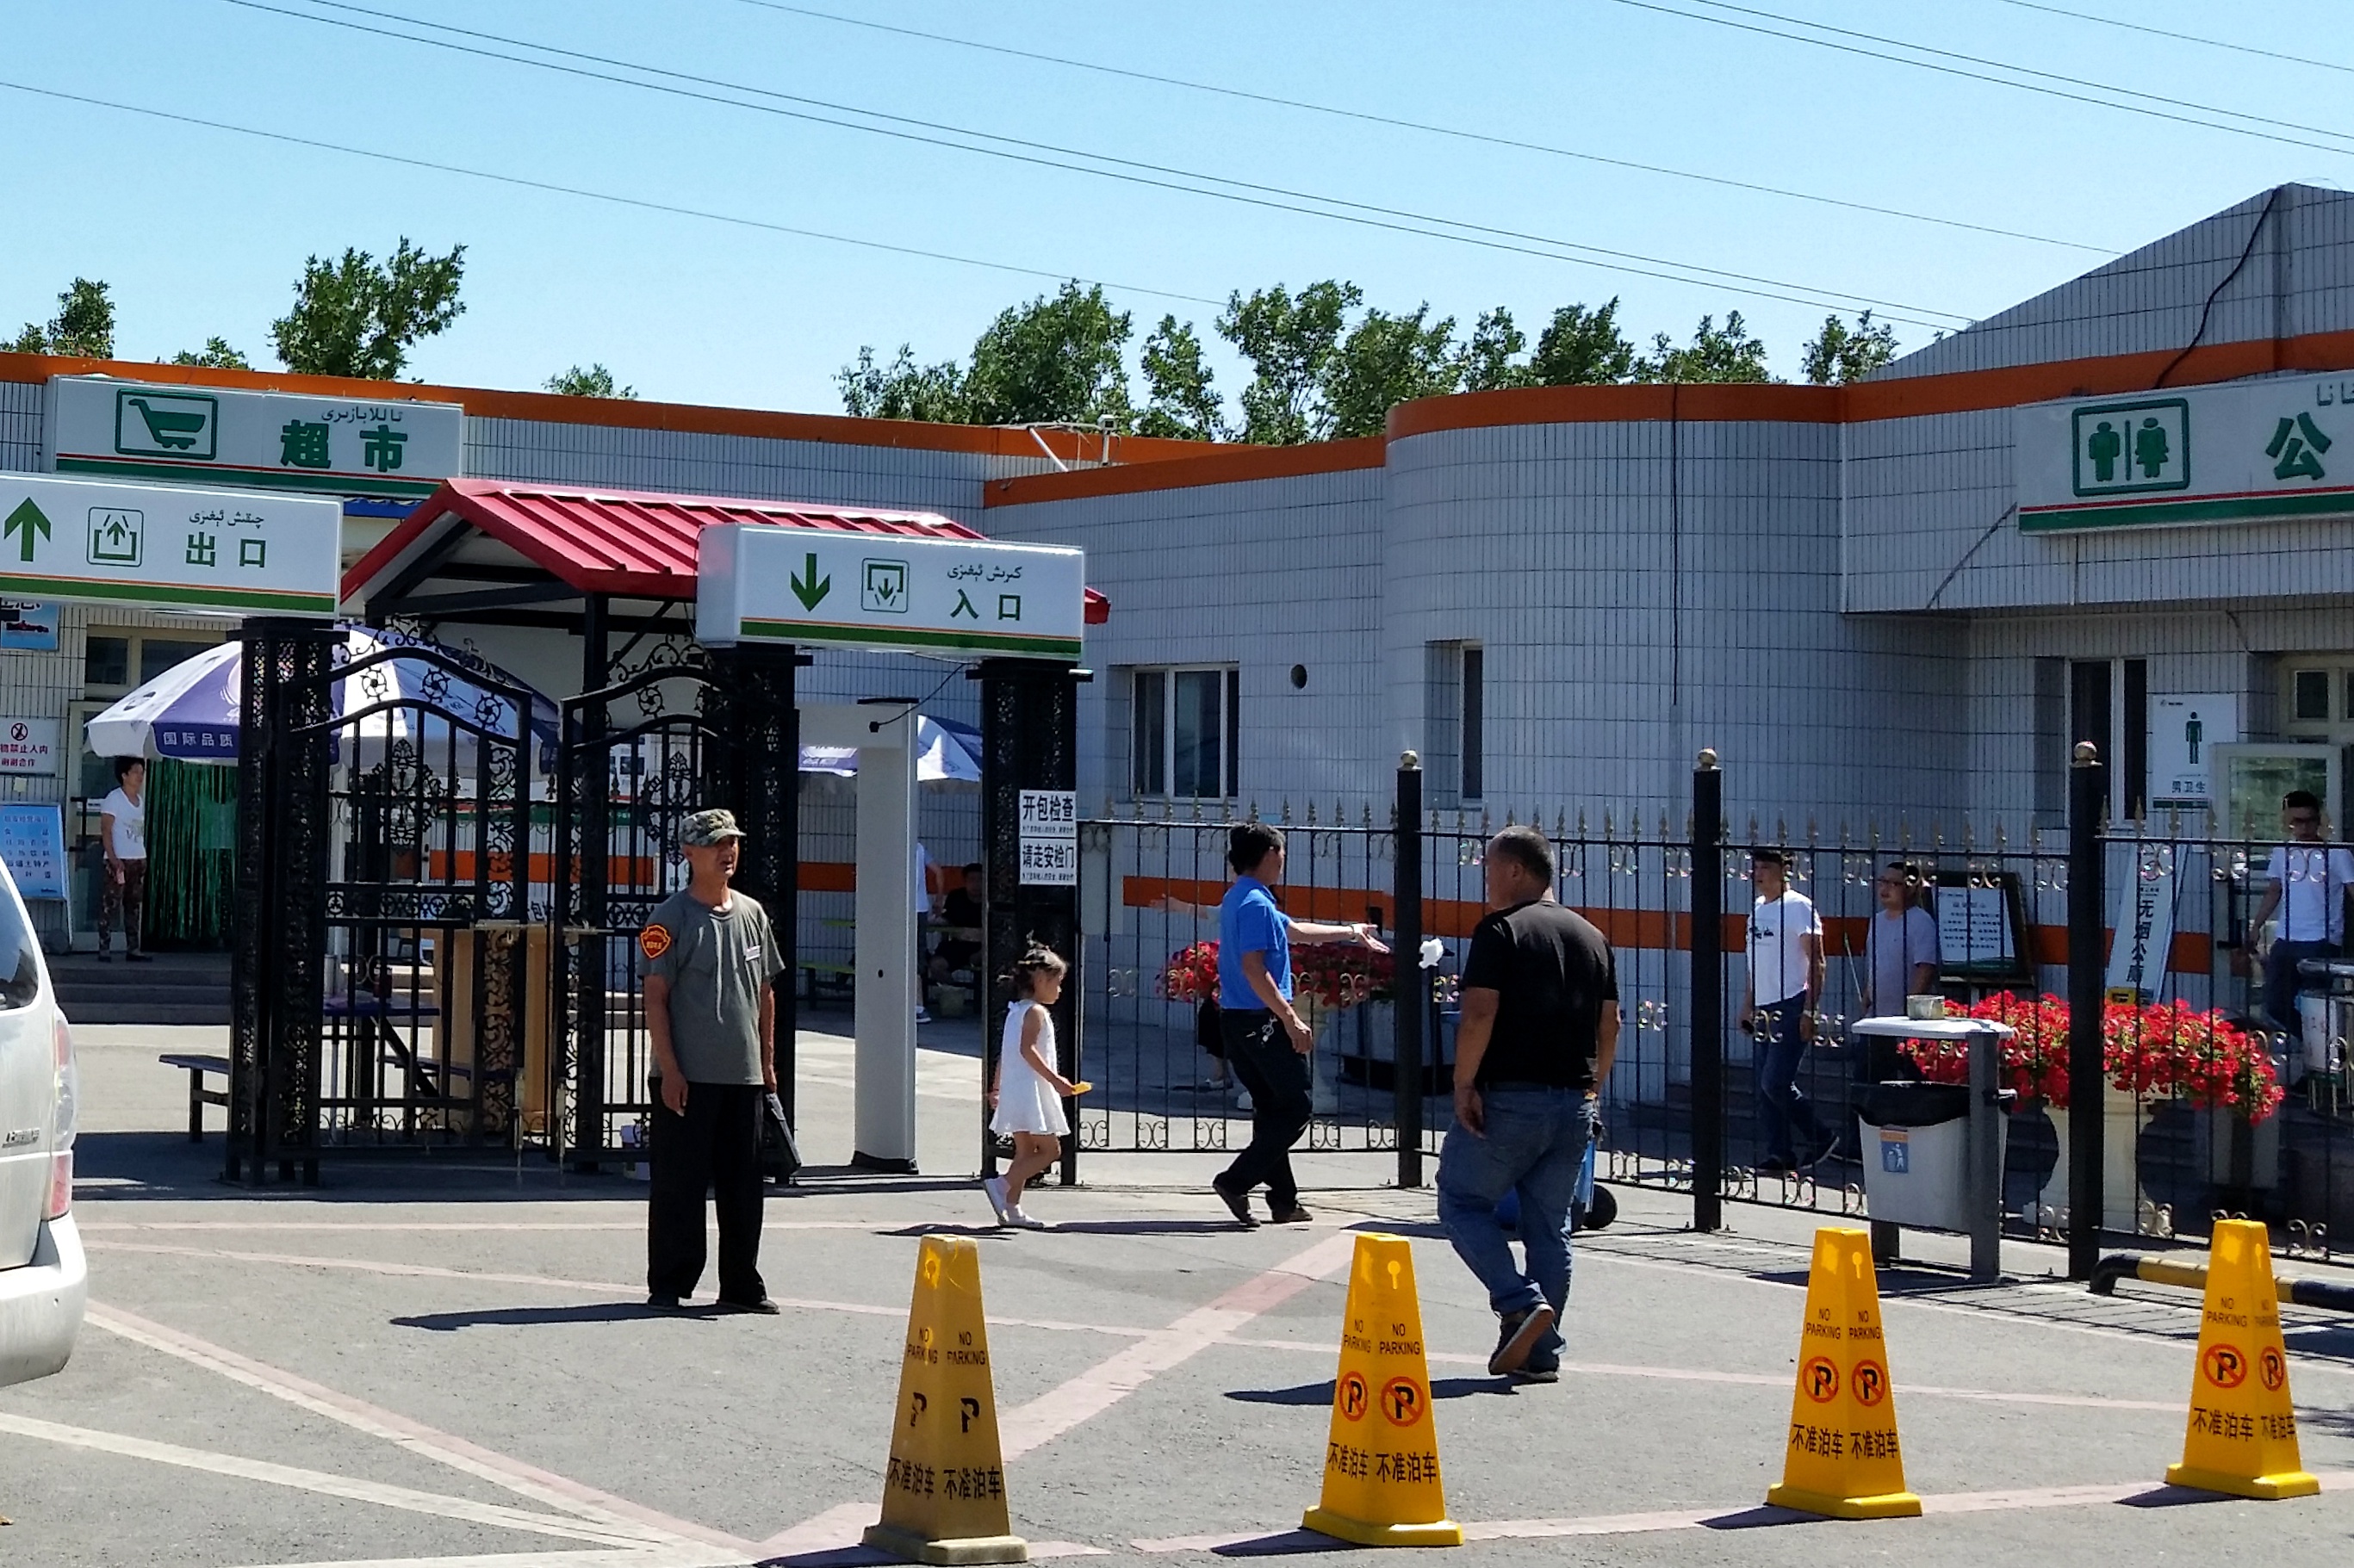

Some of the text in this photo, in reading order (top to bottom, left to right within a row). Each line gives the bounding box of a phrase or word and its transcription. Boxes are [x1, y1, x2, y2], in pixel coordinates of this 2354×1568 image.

[280, 419, 408, 473] 超市
[2265, 412, 2332, 480] 公
[186, 531, 266, 568] 出口
[950, 588, 1022, 621] 入口
[163, 731, 233, 747] 国际品质
[1022, 795, 1074, 822] 开包检查
[1022, 844, 1075, 869] 请走安检门
[2220, 1297, 2234, 1310] NO
[1819, 1308, 1830, 1322] NO
[1858, 1310, 1868, 1323] NO
[2207, 1311, 2247, 1328] PARKING
[918, 1327, 930, 1343] NO
[1354, 1319, 1363, 1334] NO
[1392, 1323, 1406, 1336] NO
[1805, 1323, 1842, 1340] PARKING
[1848, 1326, 1880, 1340] PARKING
[959, 1331, 972, 1346] NO
[1343, 1335, 1371, 1354] PARKING
[1379, 1341, 1420, 1355] PARKING
[907, 1343, 938, 1365] PARKNG
[947, 1350, 986, 1367] PARKING
[2193, 1407, 2253, 1442] 不准泊车
[1792, 1423, 1843, 1460] 不准泊车
[1850, 1429, 1897, 1459] 不准泊车
[1327, 1442, 1370, 1480] 不准泊车
[1376, 1451, 1437, 1484] 不准泊车
[888, 1456, 935, 1500] 不准泊车
[943, 1466, 1002, 1501] 不准泊车
